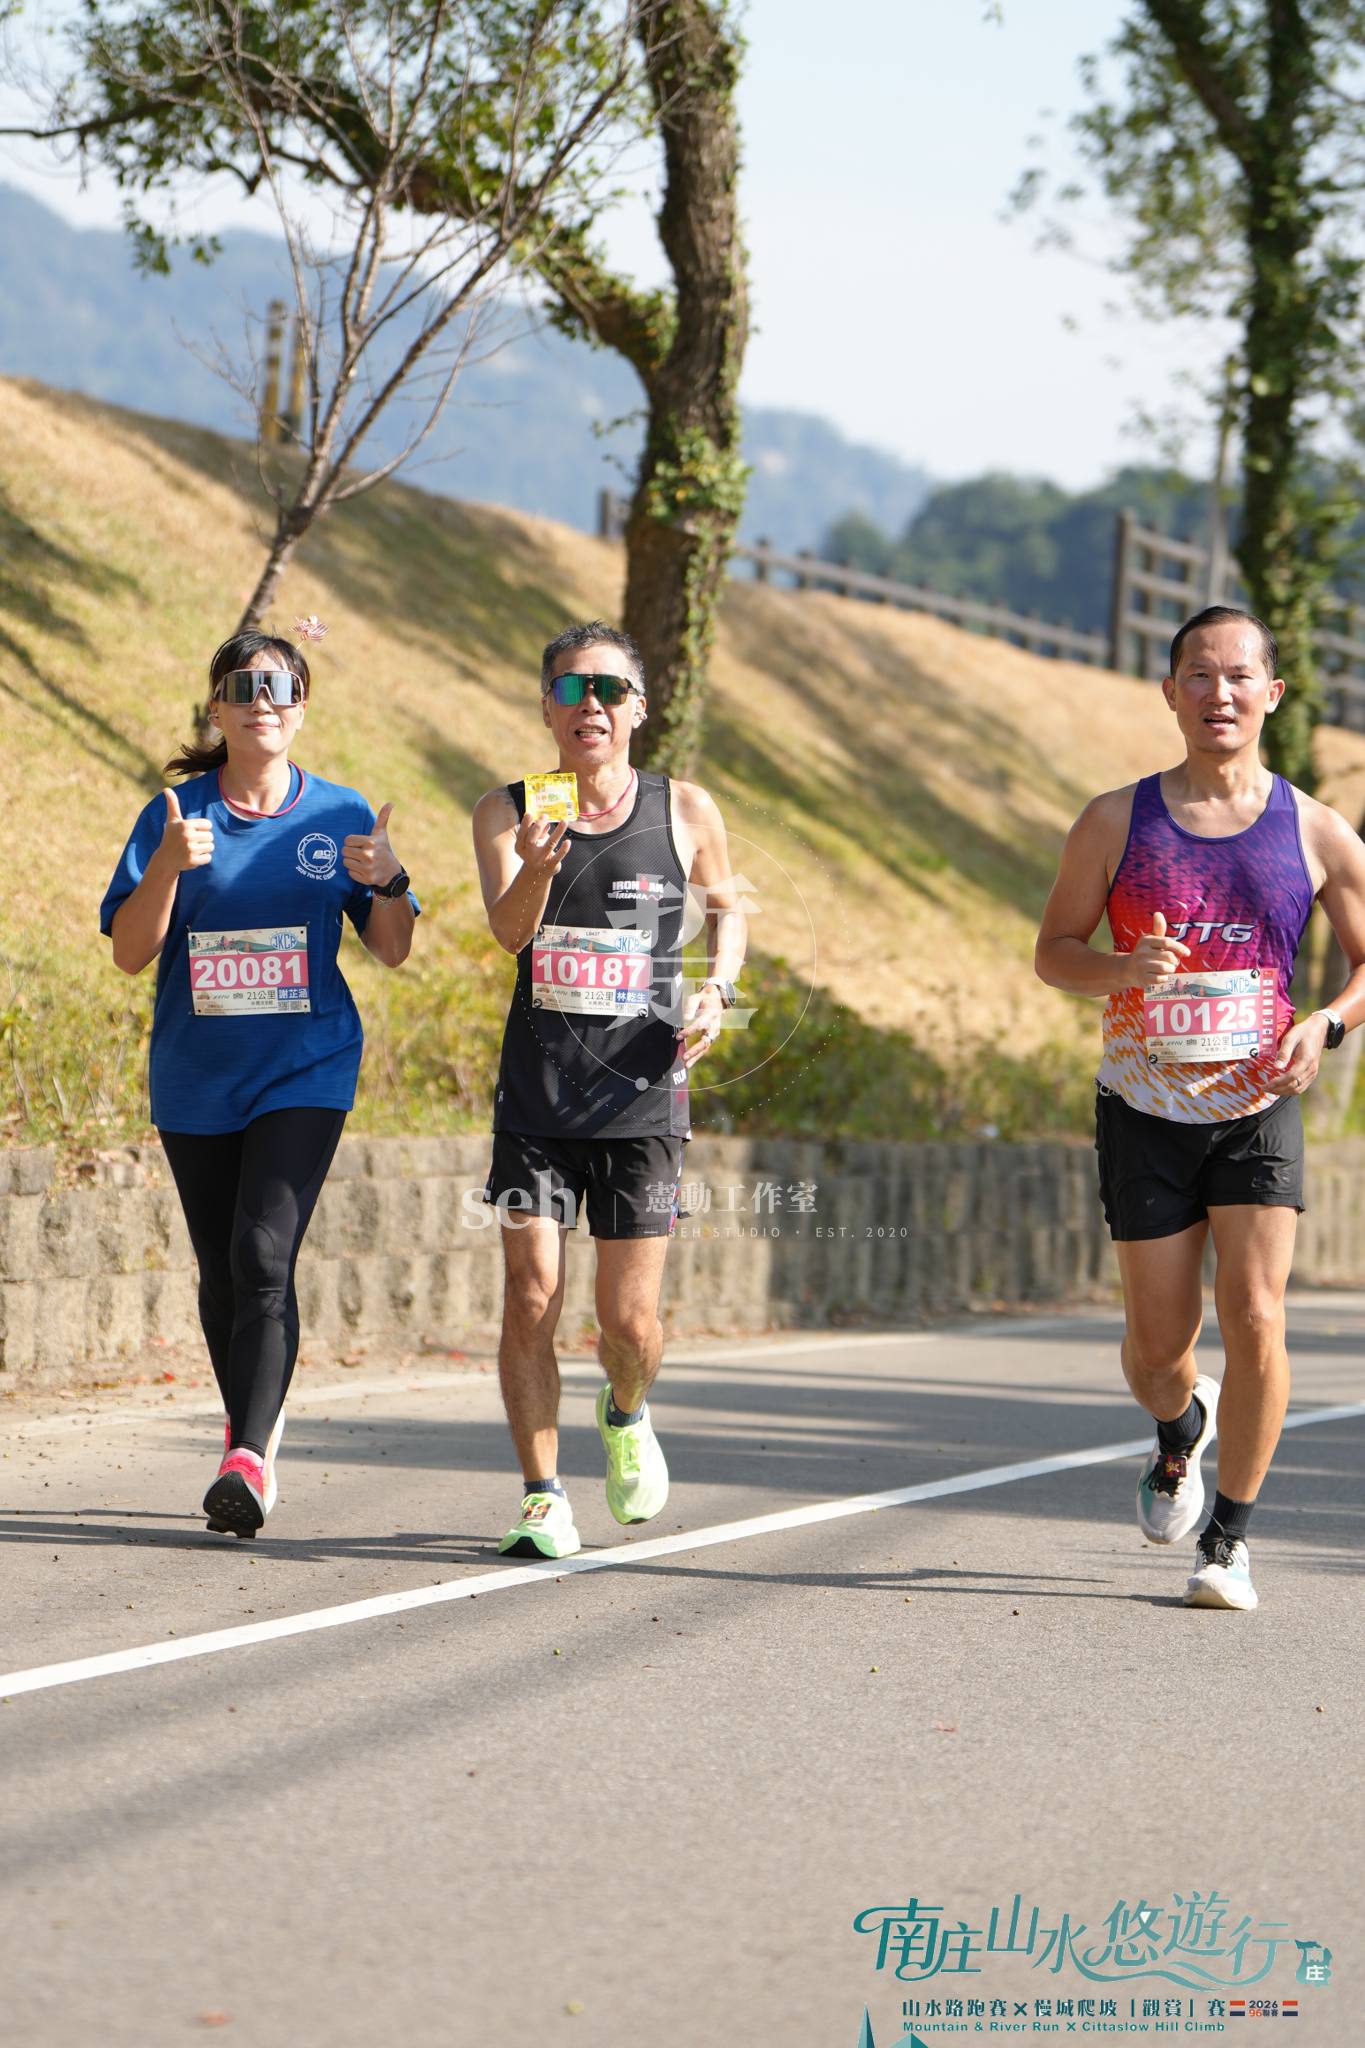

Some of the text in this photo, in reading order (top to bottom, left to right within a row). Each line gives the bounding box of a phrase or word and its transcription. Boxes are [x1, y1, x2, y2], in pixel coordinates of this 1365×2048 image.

[194, 955, 301, 989] 20081
[537, 954, 646, 987] 10187
[246, 990, 276, 1001] 21公里
[585, 991, 614, 1001] 21公里
[1148, 999, 1257, 1034] 10125
